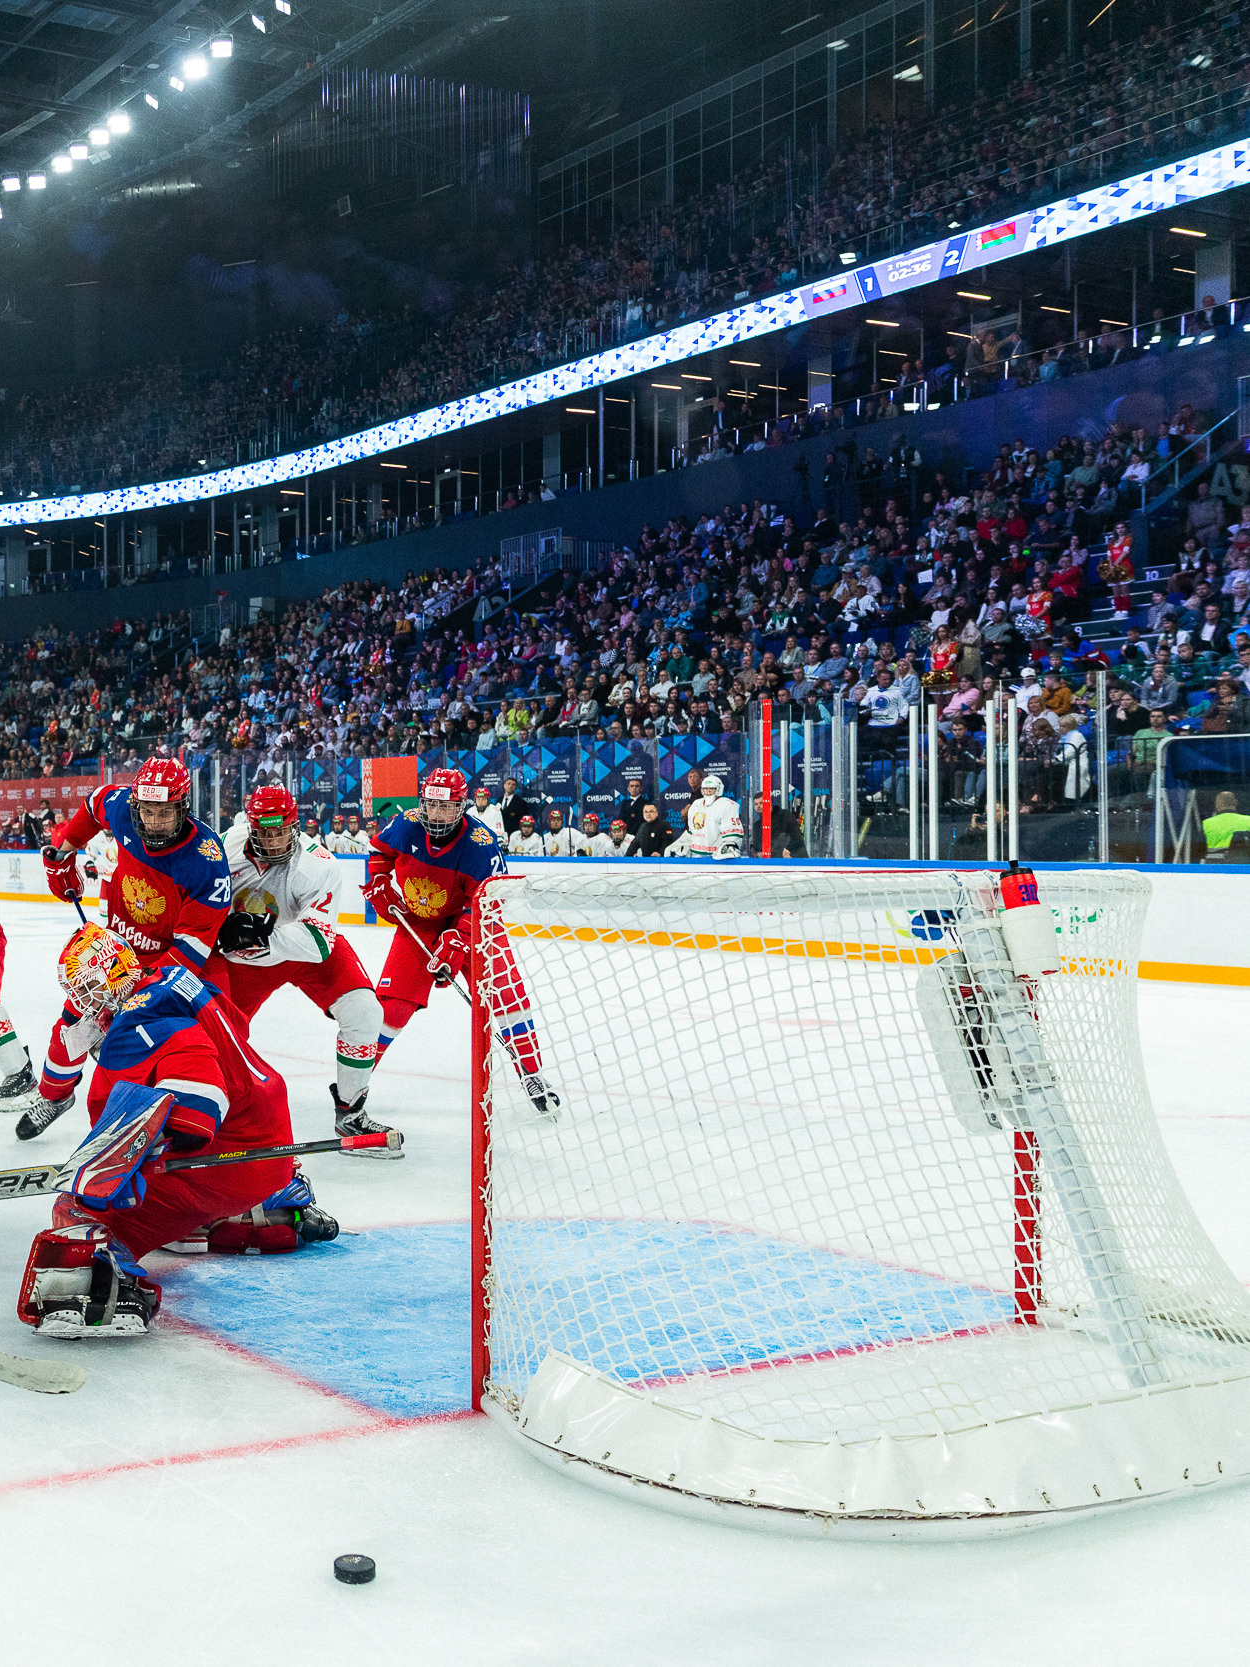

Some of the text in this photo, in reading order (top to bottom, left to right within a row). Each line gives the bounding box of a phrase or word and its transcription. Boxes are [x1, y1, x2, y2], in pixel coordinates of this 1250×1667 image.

[945, 250, 959, 266] 2
[888, 261, 931, 282] 02:36
[864, 277, 873, 291] 1
[1145, 570, 1160, 581] 10
[145, 773, 163, 782] 28
[586, 795, 613, 803] СИБИРЬ
[208, 875, 231, 903] 28
[1018, 884, 1038, 902] 30
[111, 913, 161, 951] РОССИЯ
[136, 1024, 155, 1048] 1
[218, 1151, 247, 1159] MACH
